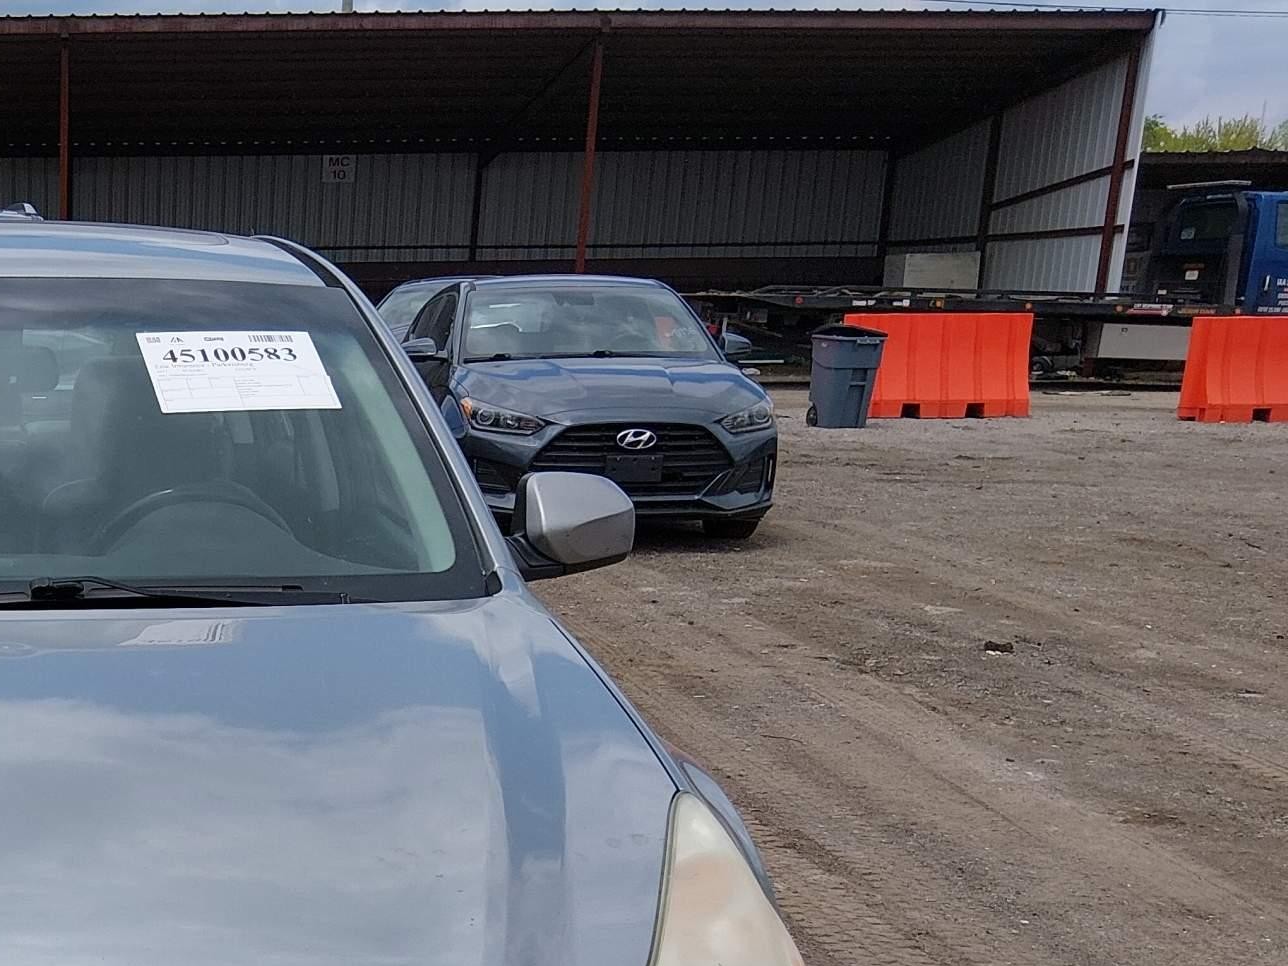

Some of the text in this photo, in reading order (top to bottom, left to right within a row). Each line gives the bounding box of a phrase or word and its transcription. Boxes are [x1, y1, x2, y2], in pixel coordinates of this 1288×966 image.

[328, 156, 350, 167] MC
[330, 169, 346, 180] 10
[162, 346, 297, 363] 45100583
